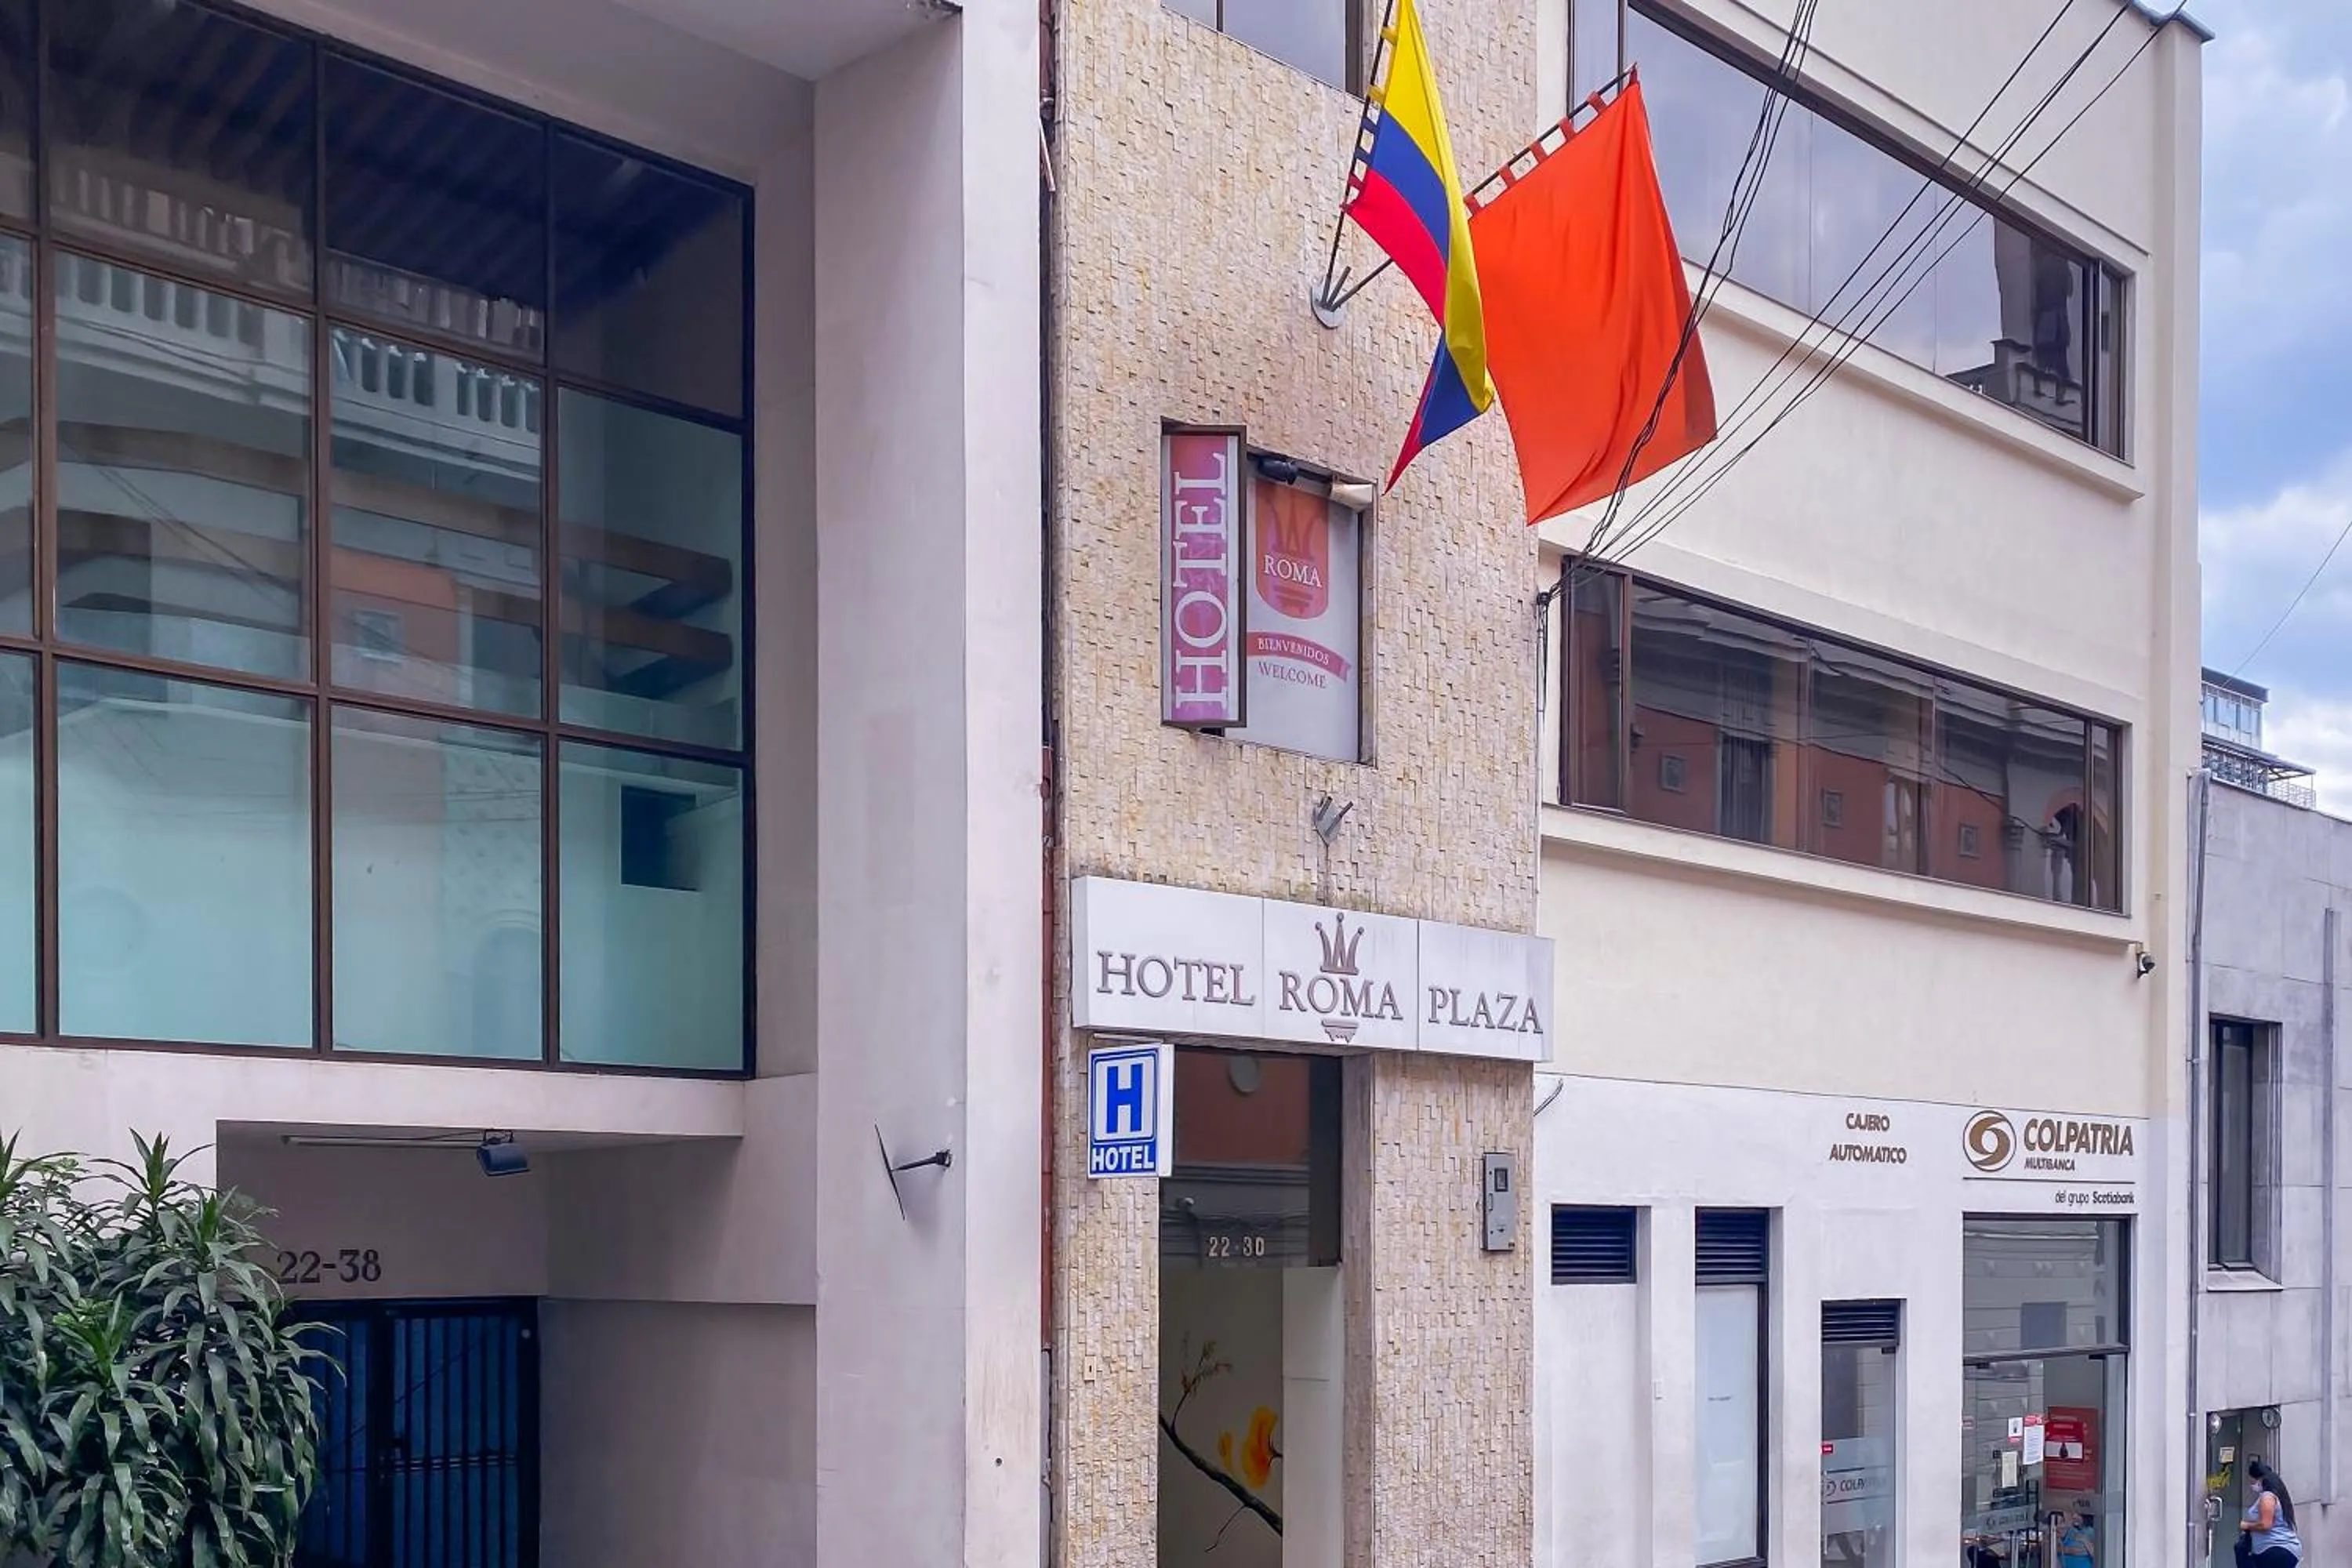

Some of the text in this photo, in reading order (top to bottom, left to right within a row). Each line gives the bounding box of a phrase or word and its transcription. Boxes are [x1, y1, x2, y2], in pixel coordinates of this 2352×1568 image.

[1173, 452, 1228, 708] HOTEL
[1264, 554, 1322, 588] ROMA
[1258, 637, 1329, 666] BIENVENIDOS
[1258, 661, 1326, 689] WELCOME
[1097, 950, 1544, 1034] HOTEL ROMA PLAZA
[1106, 1063, 1143, 1134] H
[1846, 1112, 1890, 1132] CAJERO
[2024, 1118, 2134, 1156] COLPATRIA
[1091, 1145, 1155, 1171] HOTEL
[1829, 1144, 1907, 1165] AUTOMATICO
[2024, 1156, 2076, 1171] MULTIBANCA
[2055, 1189, 2067, 1203] del
[2092, 1190, 2135, 1205] Scotiabank
[277, 1249, 383, 1284] 22-38
